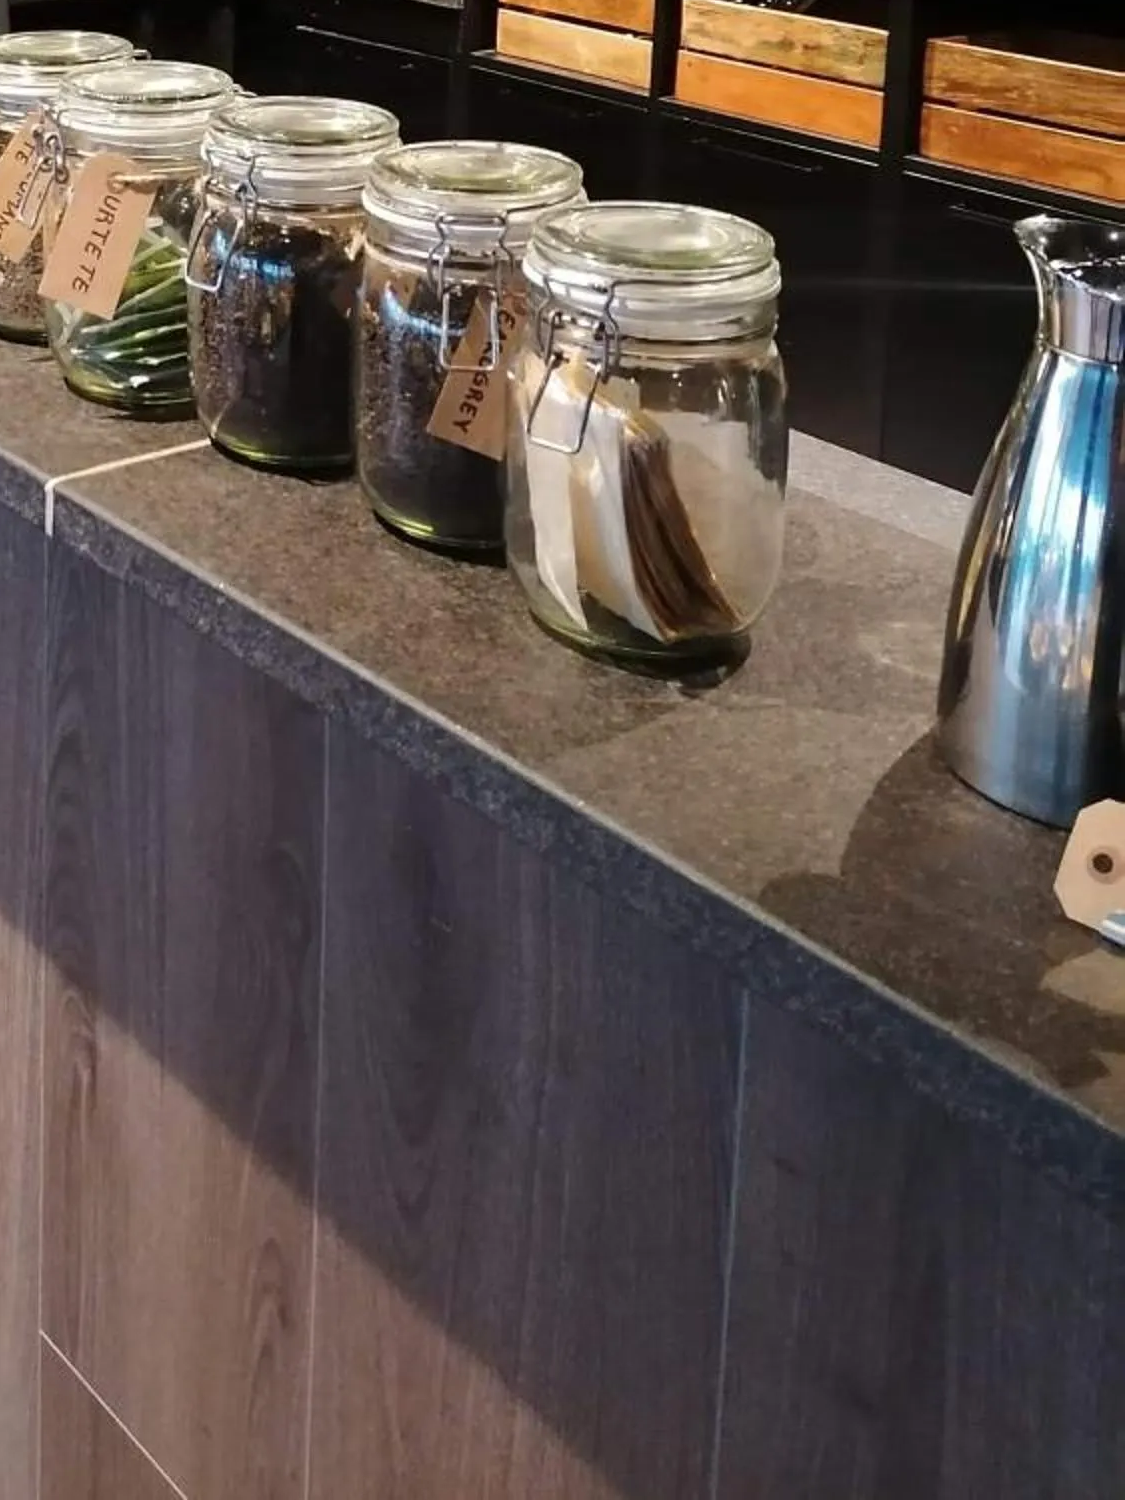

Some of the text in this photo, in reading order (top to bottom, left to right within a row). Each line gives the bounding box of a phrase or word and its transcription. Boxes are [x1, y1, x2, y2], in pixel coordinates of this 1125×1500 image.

[72, 195, 121, 293] URTE TE
[453, 371, 489, 434] GREY
